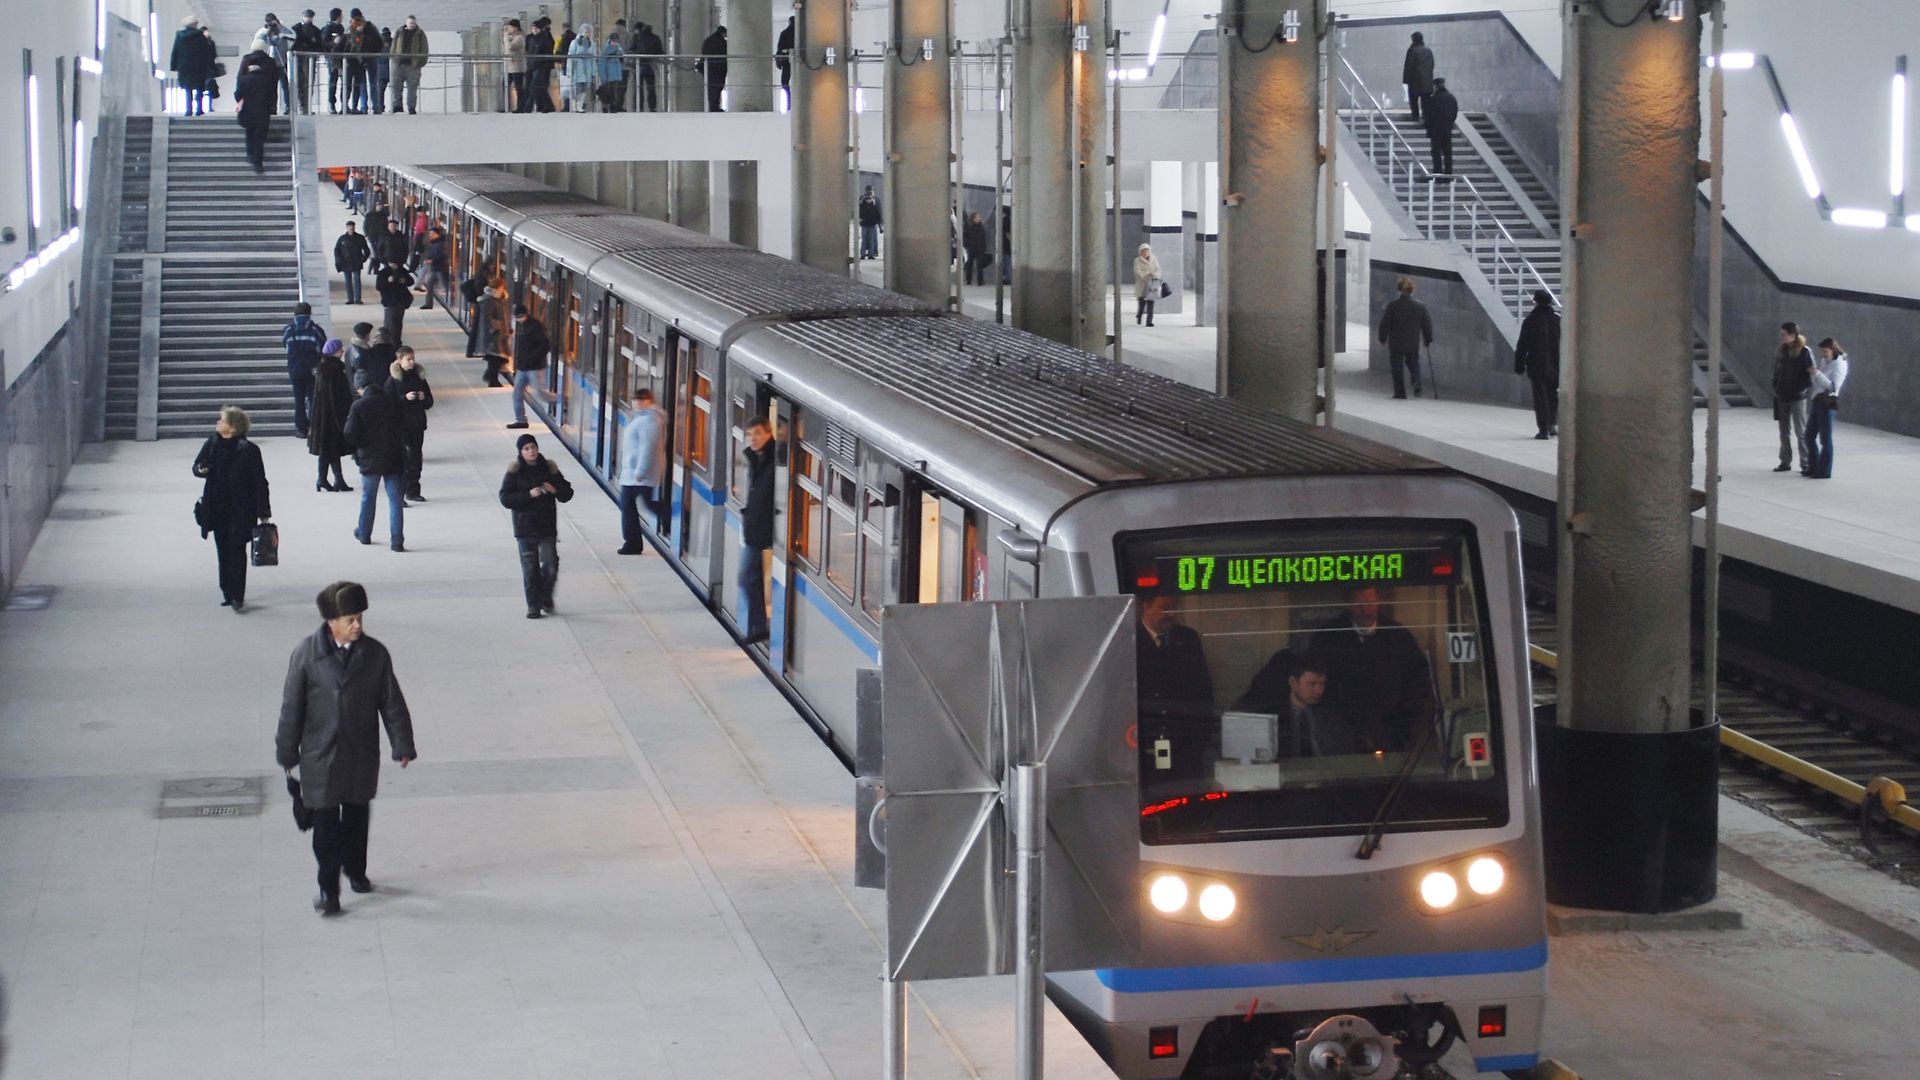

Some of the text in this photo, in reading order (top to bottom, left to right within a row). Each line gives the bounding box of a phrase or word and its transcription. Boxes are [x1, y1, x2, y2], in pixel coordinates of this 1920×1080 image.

[1178, 554, 1402, 591] 07 ЩЕЛКОВСКАЯ
[1451, 636, 1473, 659] 07
